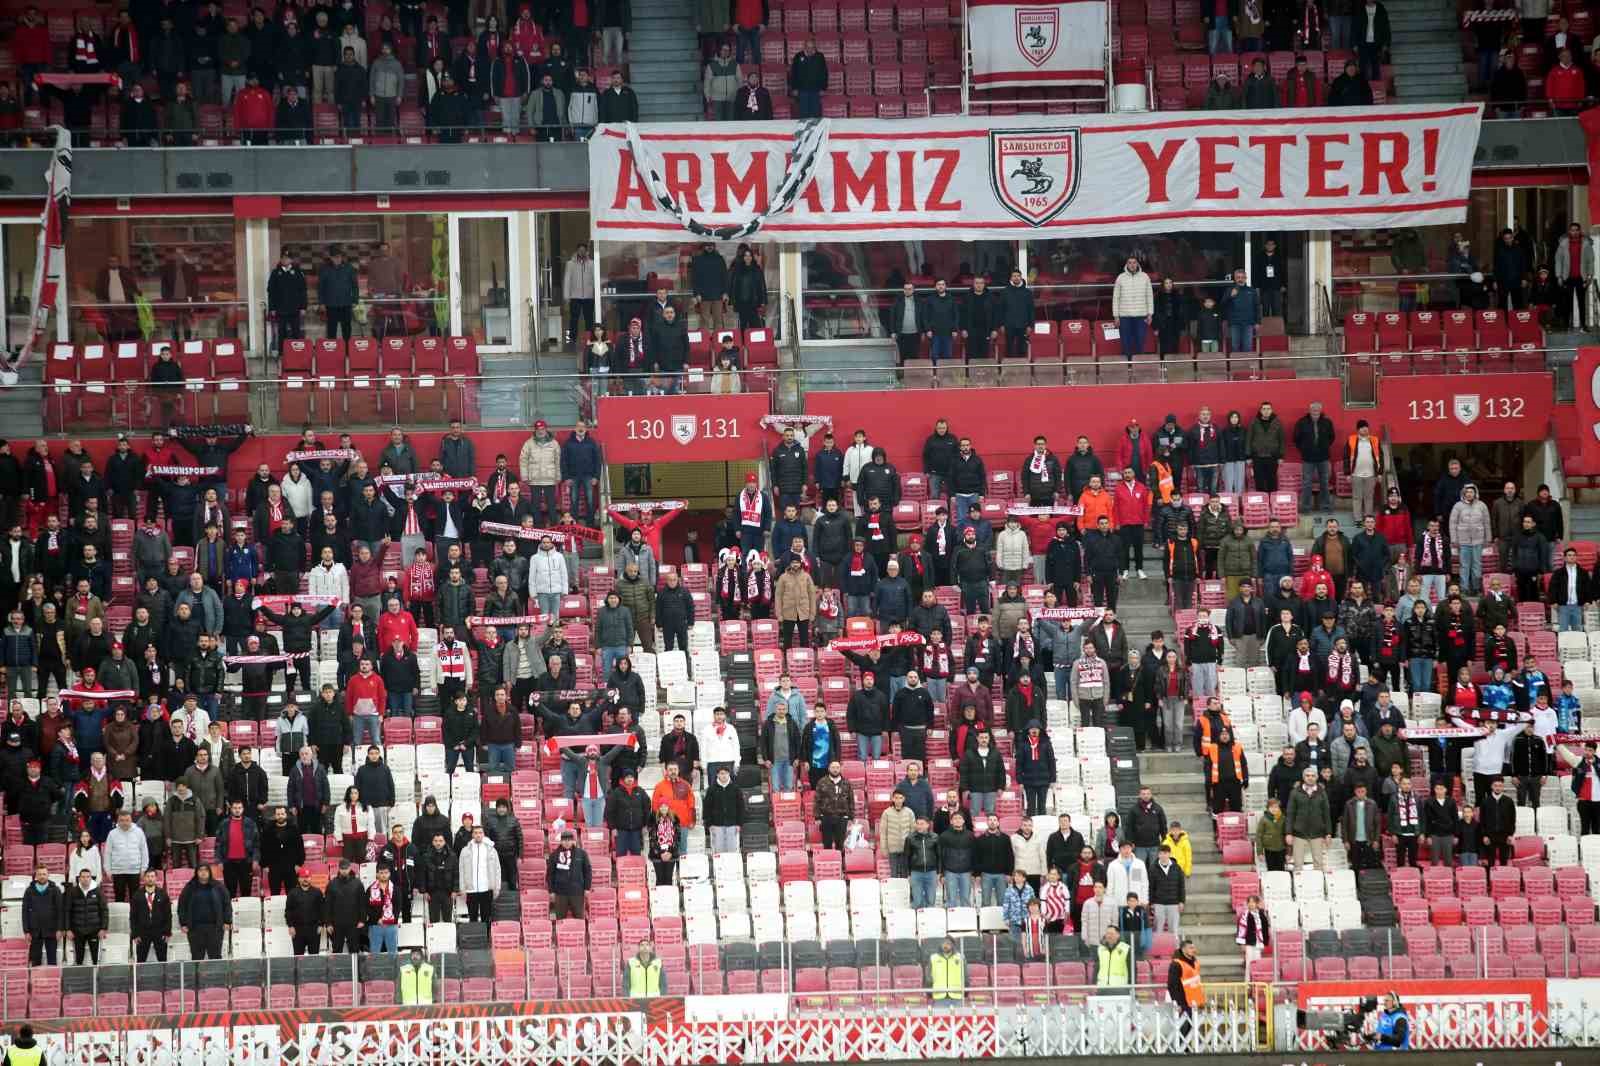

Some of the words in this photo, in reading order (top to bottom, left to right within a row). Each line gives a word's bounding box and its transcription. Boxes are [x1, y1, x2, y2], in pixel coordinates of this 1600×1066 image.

[1003, 141, 1067, 151] SAMSUNSPOR
[1127, 129, 1440, 204] YETER!
[1024, 196, 1048, 207] 1965
[1408, 399, 1448, 420] 131
[1485, 397, 1525, 418] 132
[626, 419, 665, 440] 130
[702, 418, 741, 439] 131
[153, 465, 205, 475] SAMSUNSPOR
